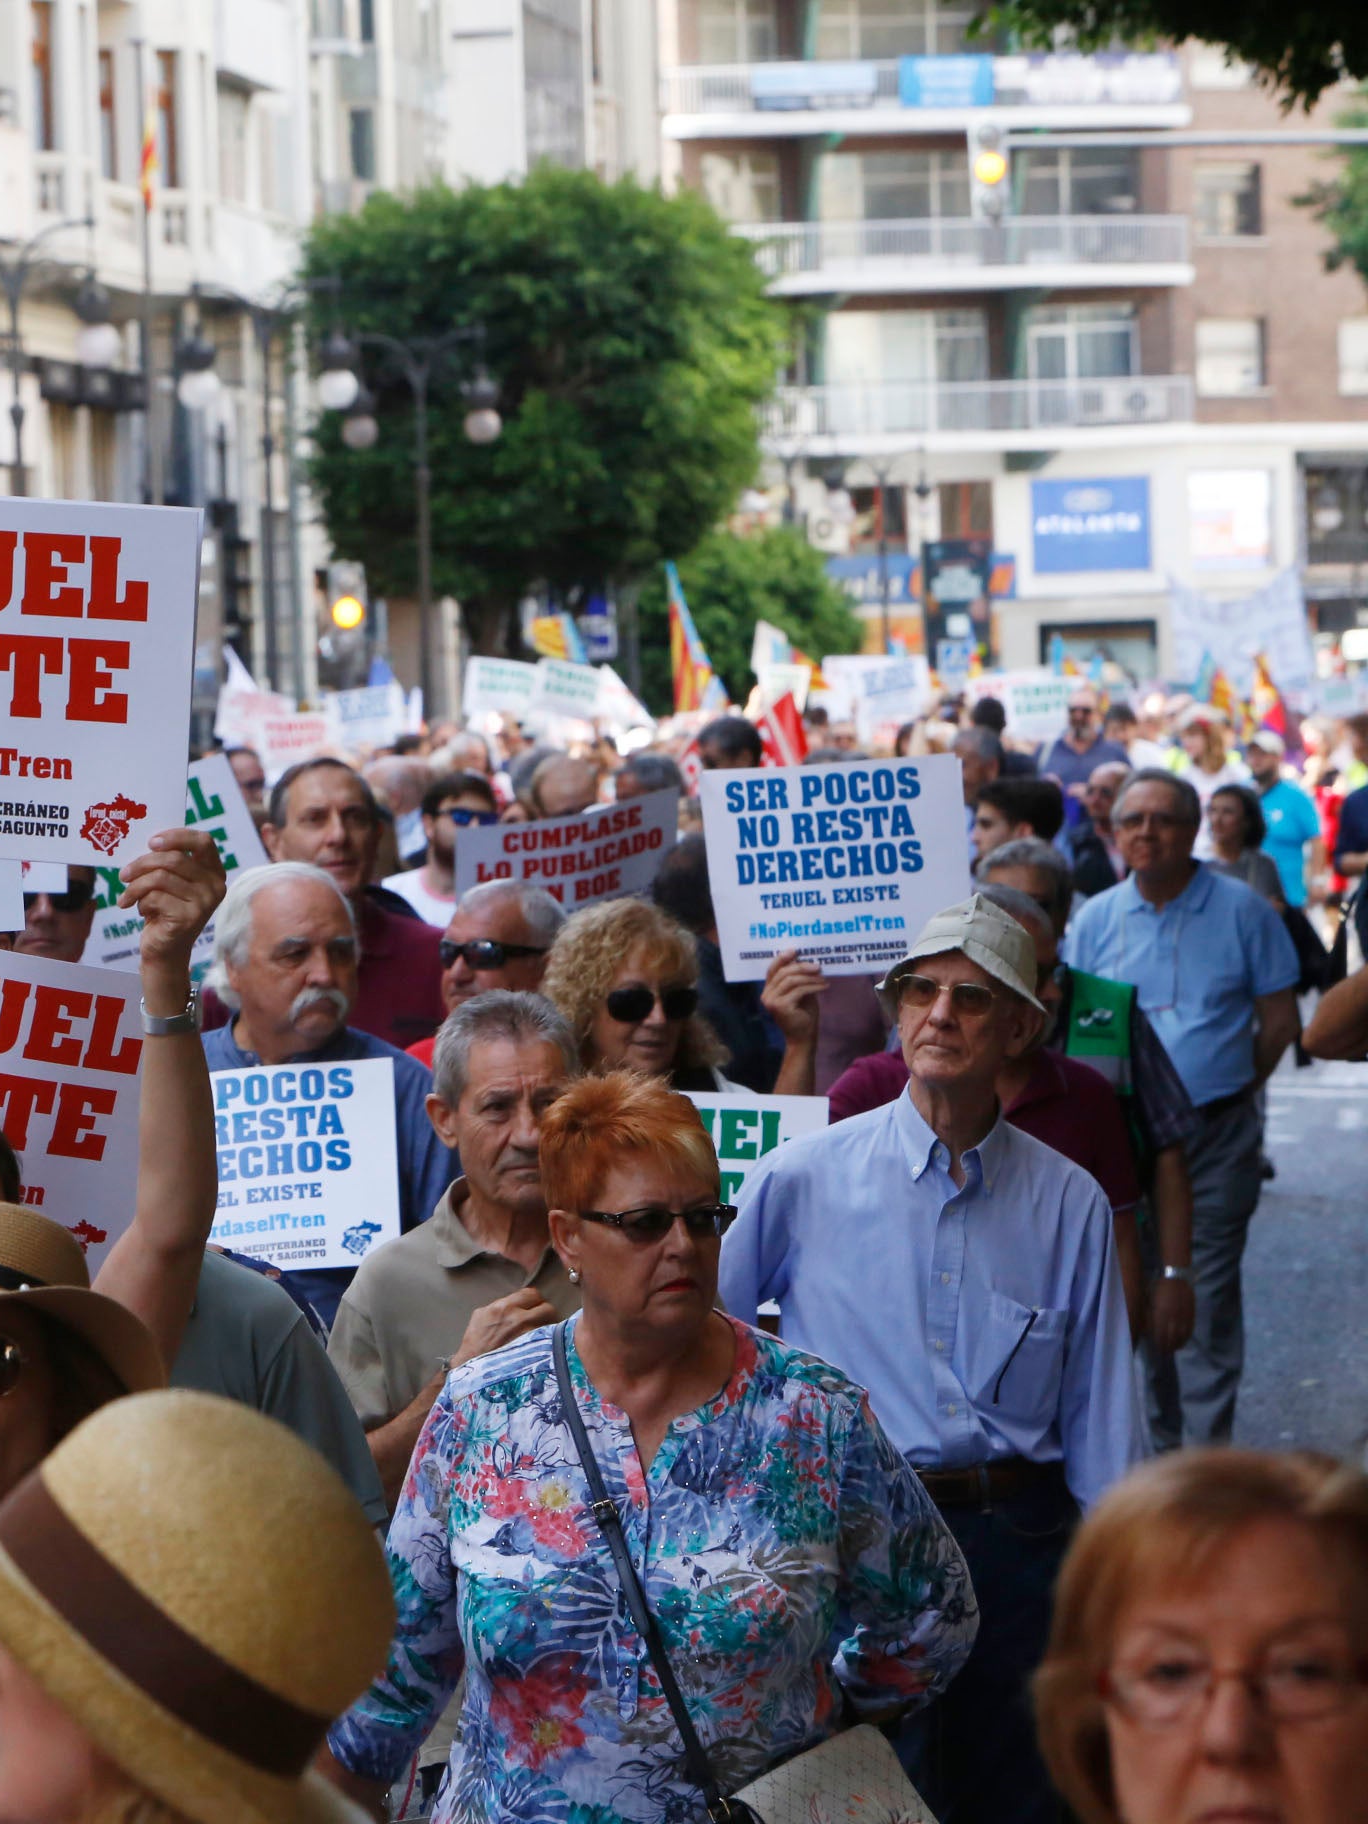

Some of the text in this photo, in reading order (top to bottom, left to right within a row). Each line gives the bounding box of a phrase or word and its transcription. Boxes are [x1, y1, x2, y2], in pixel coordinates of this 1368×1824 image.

[726, 766, 921, 813] SER POCOS
[737, 804, 915, 849] NO RESTA
[477, 827, 664, 883] LO PUBLICADO
[735, 840, 924, 885] DERECHOS
[574, 868, 621, 903] BOE
[759, 884, 900, 909] TERUEL EXISTE
[749, 915, 905, 941] #NoPierdaselTren
[215, 1067, 354, 1110] POCOS
[217, 1139, 352, 1182] ECHOS
[246, 1182, 323, 1205] EXISTE
[211, 1213, 326, 1239] rdaselTren
[277, 1248, 326, 1261] SAGUNTO
